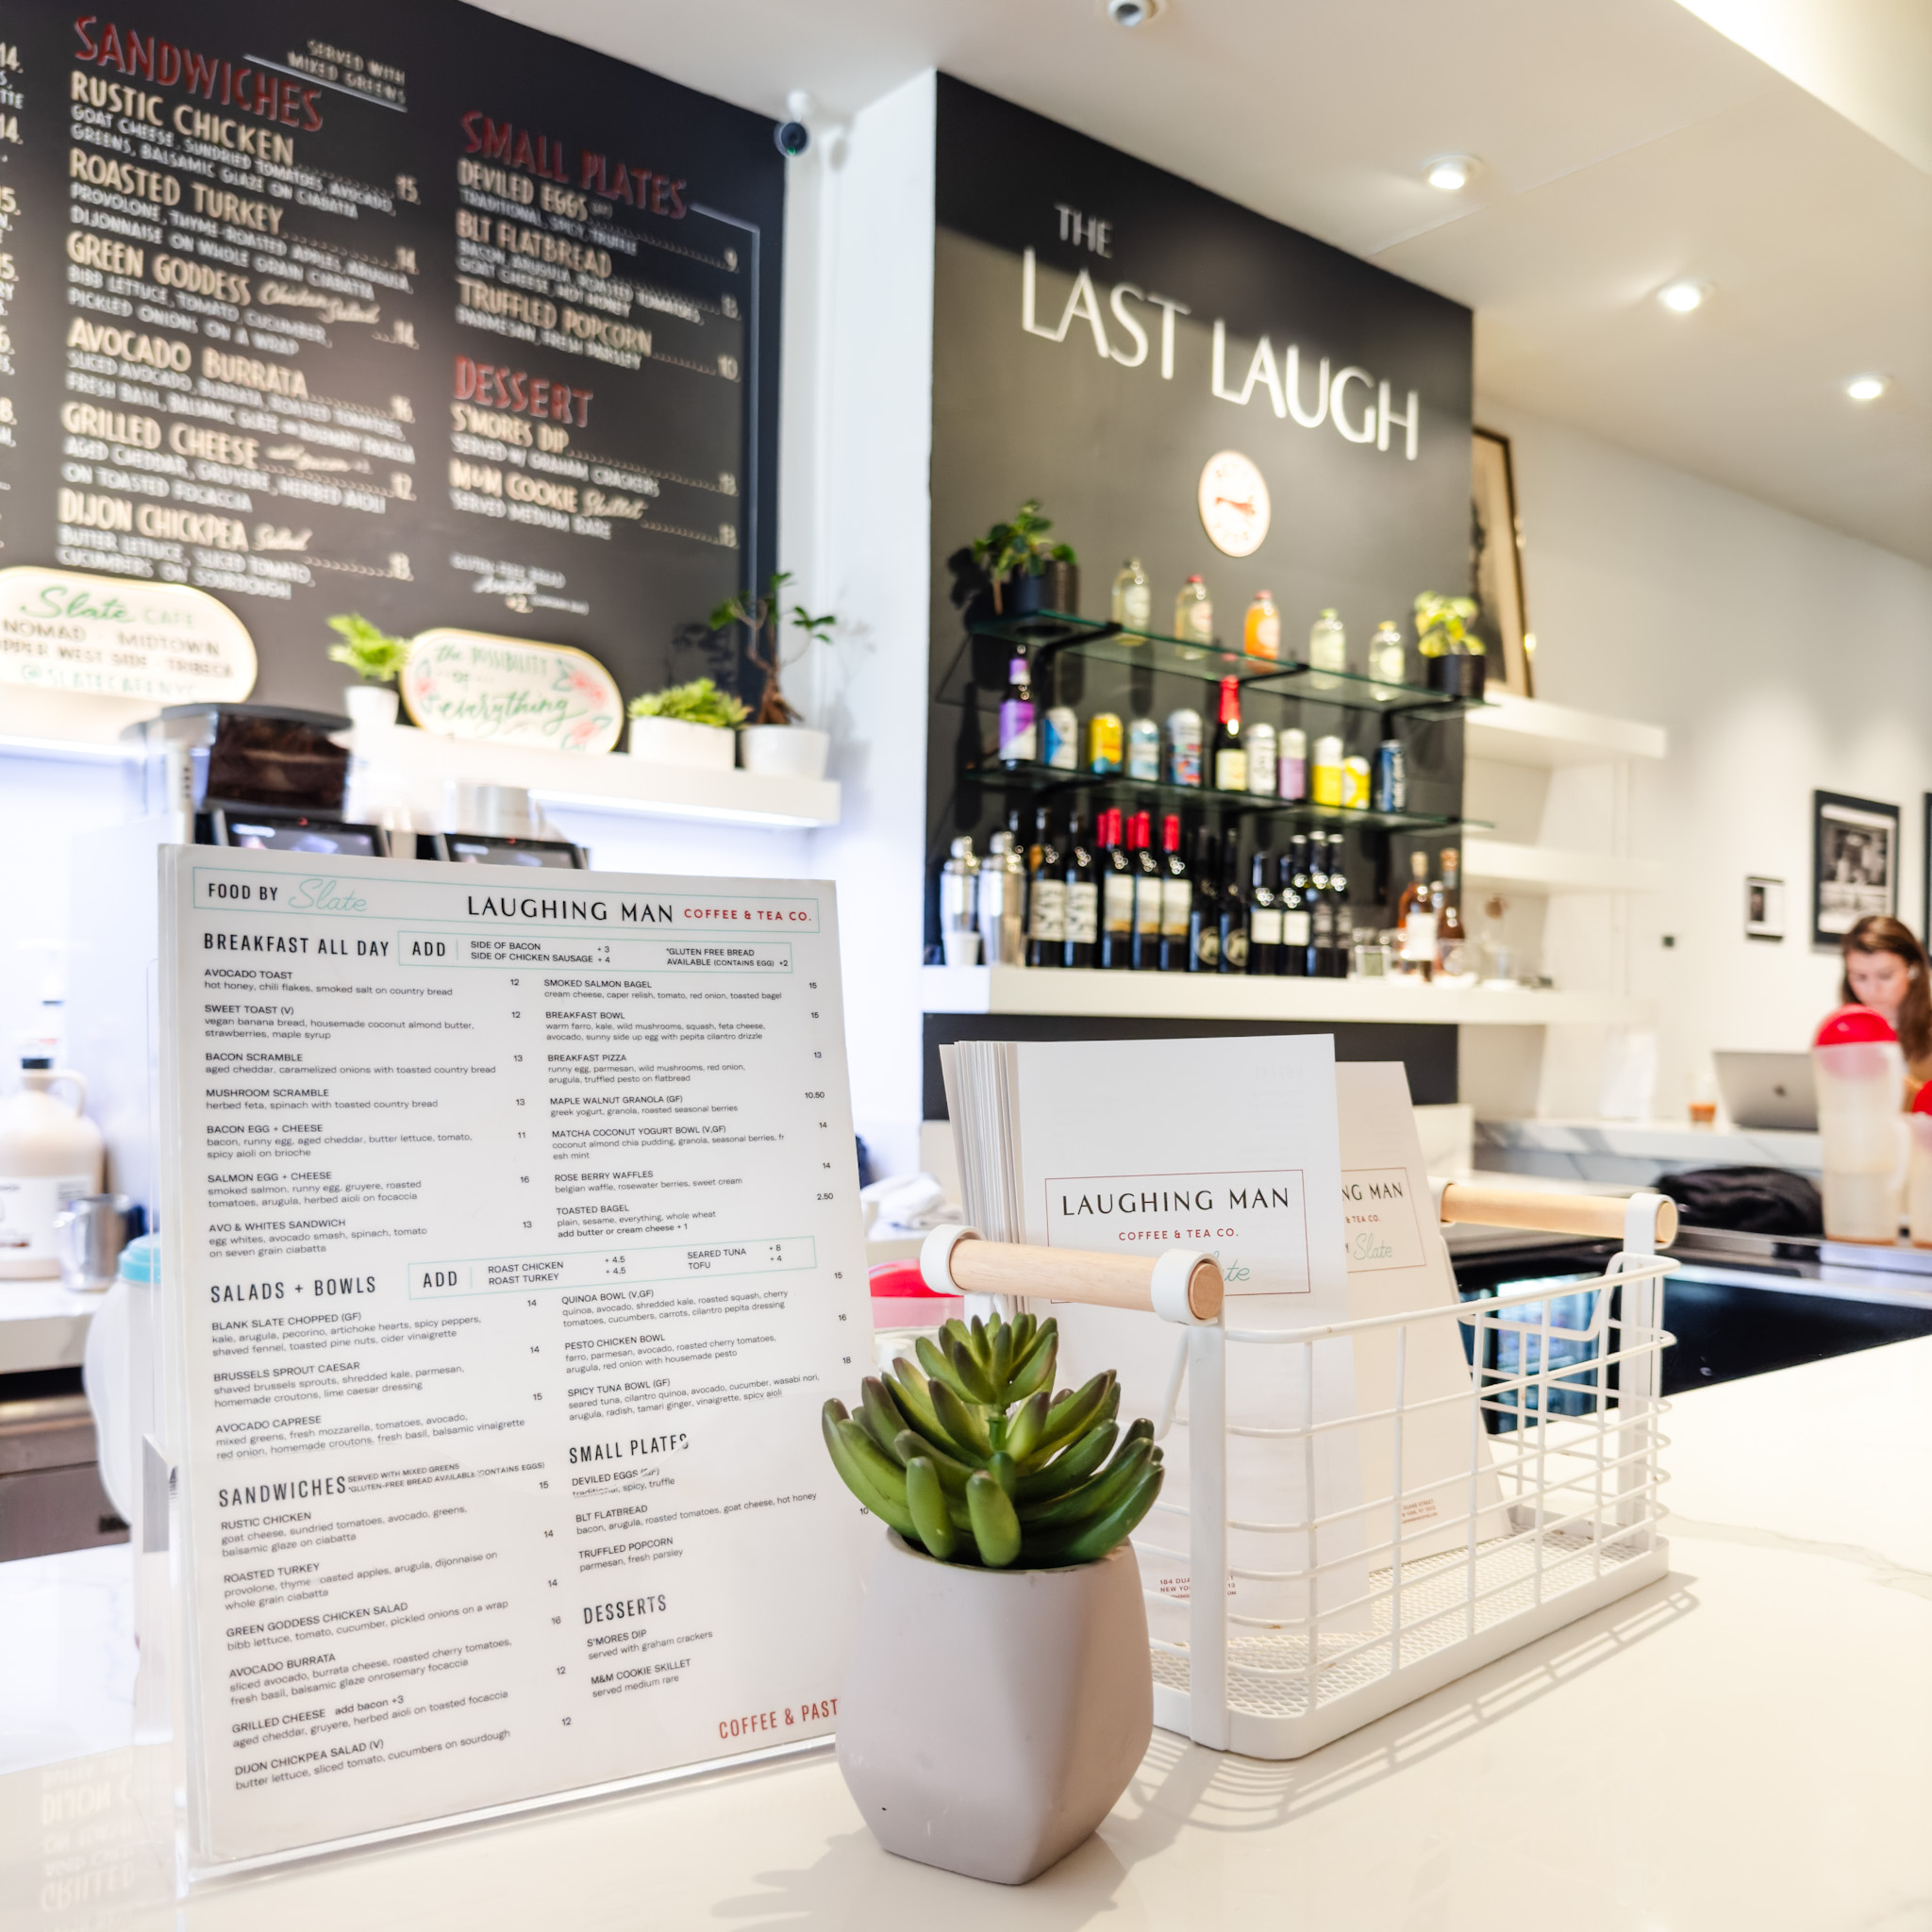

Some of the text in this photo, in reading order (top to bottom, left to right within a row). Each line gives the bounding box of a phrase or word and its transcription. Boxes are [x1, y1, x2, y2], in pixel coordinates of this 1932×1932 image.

[75, 15, 323, 131] SANDWICHES
[70, 70, 294, 167] RUSTIC CHICKEN
[460, 109, 689, 221] SMALL PLATES
[69, 147, 181, 207] ROASTED
[190, 182, 284, 235] TURKEY
[457, 157, 534, 206] DEVILED
[539, 183, 589, 223] EGGS
[455, 208, 613, 280] BLT FLATBREAD
[1054, 201, 1113, 259] THE
[66, 230, 252, 308] GREEN GODDESS
[455, 275, 558, 329] TRUFFLED
[560, 306, 653, 358] POPCORN
[67, 316, 309, 399] AVOCADO BURRATA
[1022, 245, 1419, 461] LAST LAUGH
[454, 355, 594, 428] DESSERT
[60, 401, 162, 451] GRILLED
[167, 421, 260, 471] CHEESE
[537, 422, 570, 455] DIP
[504, 472, 579, 514] COOKIE
[57, 487, 133, 532] DIJON
[135, 502, 250, 553] CHICKPEA
[19, 585, 135, 625] Slate
[3, 618, 221, 658] NOMAD MIDTOWN
[440, 690, 590, 739] everything
[208, 877, 369, 912] FOOD BY Slate
[468, 895, 672, 923] LAUGHING MAN
[683, 908, 811, 921] COFFEE & TEA CO.
[204, 932, 389, 957] BREAKFAST ALL DAY
[411, 941, 445, 957] ADD
[470, 941, 491, 949] SIDE
[508, 941, 541, 950] BACON
[471, 951, 592, 962] SIDE OF CHICKEN SAUSAGE
[726, 948, 755, 957] BREAD
[204, 968, 292, 979] AVOCADO TOAST
[543, 978, 652, 989] SMOKED SALMON BAGEL
[204, 980, 221, 989] hot
[224, 981, 257, 991] honey,
[258, 982, 279, 991] chili
[281, 982, 313, 992] flakes,
[315, 985, 353, 993] smoked
[355, 986, 373, 994] salt
[389, 988, 425, 996] country
[426, 987, 453, 995] bread
[545, 1010, 597, 1019] BREAKFAST
[547, 1054, 600, 1062] BREAKFAST
[582, 1096, 620, 1105] WALNUT
[622, 1095, 664, 1104] GRANOLA
[666, 1094, 683, 1104] (GF)
[805, 1091, 824, 1099] 10.50
[1062, 1187, 1288, 1215] LAUGHING MAN
[1368, 1182, 1403, 1199] MAN
[1118, 1227, 1238, 1241] COFFEE & TEA CO.
[1353, 1231, 1393, 1261] Slate
[210, 1275, 375, 1303] SALADS + BOWLS
[423, 1271, 458, 1288] ADD
[213, 1361, 360, 1382] BRUSSELS SPROUT CAESAR
[569, 1441, 623, 1464] SMALL
[218, 1475, 347, 1507] SANDWICHES
[539, 1480, 549, 1490] 15
[221, 1511, 311, 1530] RUSTIC CHICKEN
[575, 1492, 817, 1535] bacon, arugula, roasted tomatoes, goat cheese, hot honey
[575, 1505, 648, 1523] BLT FLATBREAD
[583, 1593, 666, 1624] DESSERTS
[587, 1628, 647, 1647] S'MORES DIP
[588, 1631, 713, 1660] served with graham crackers
[591, 1657, 691, 1685] M&M COOKIE SKILLET
[591, 1674, 679, 1698] served medium rare
[718, 1698, 838, 1740] COFFEE & PAST
